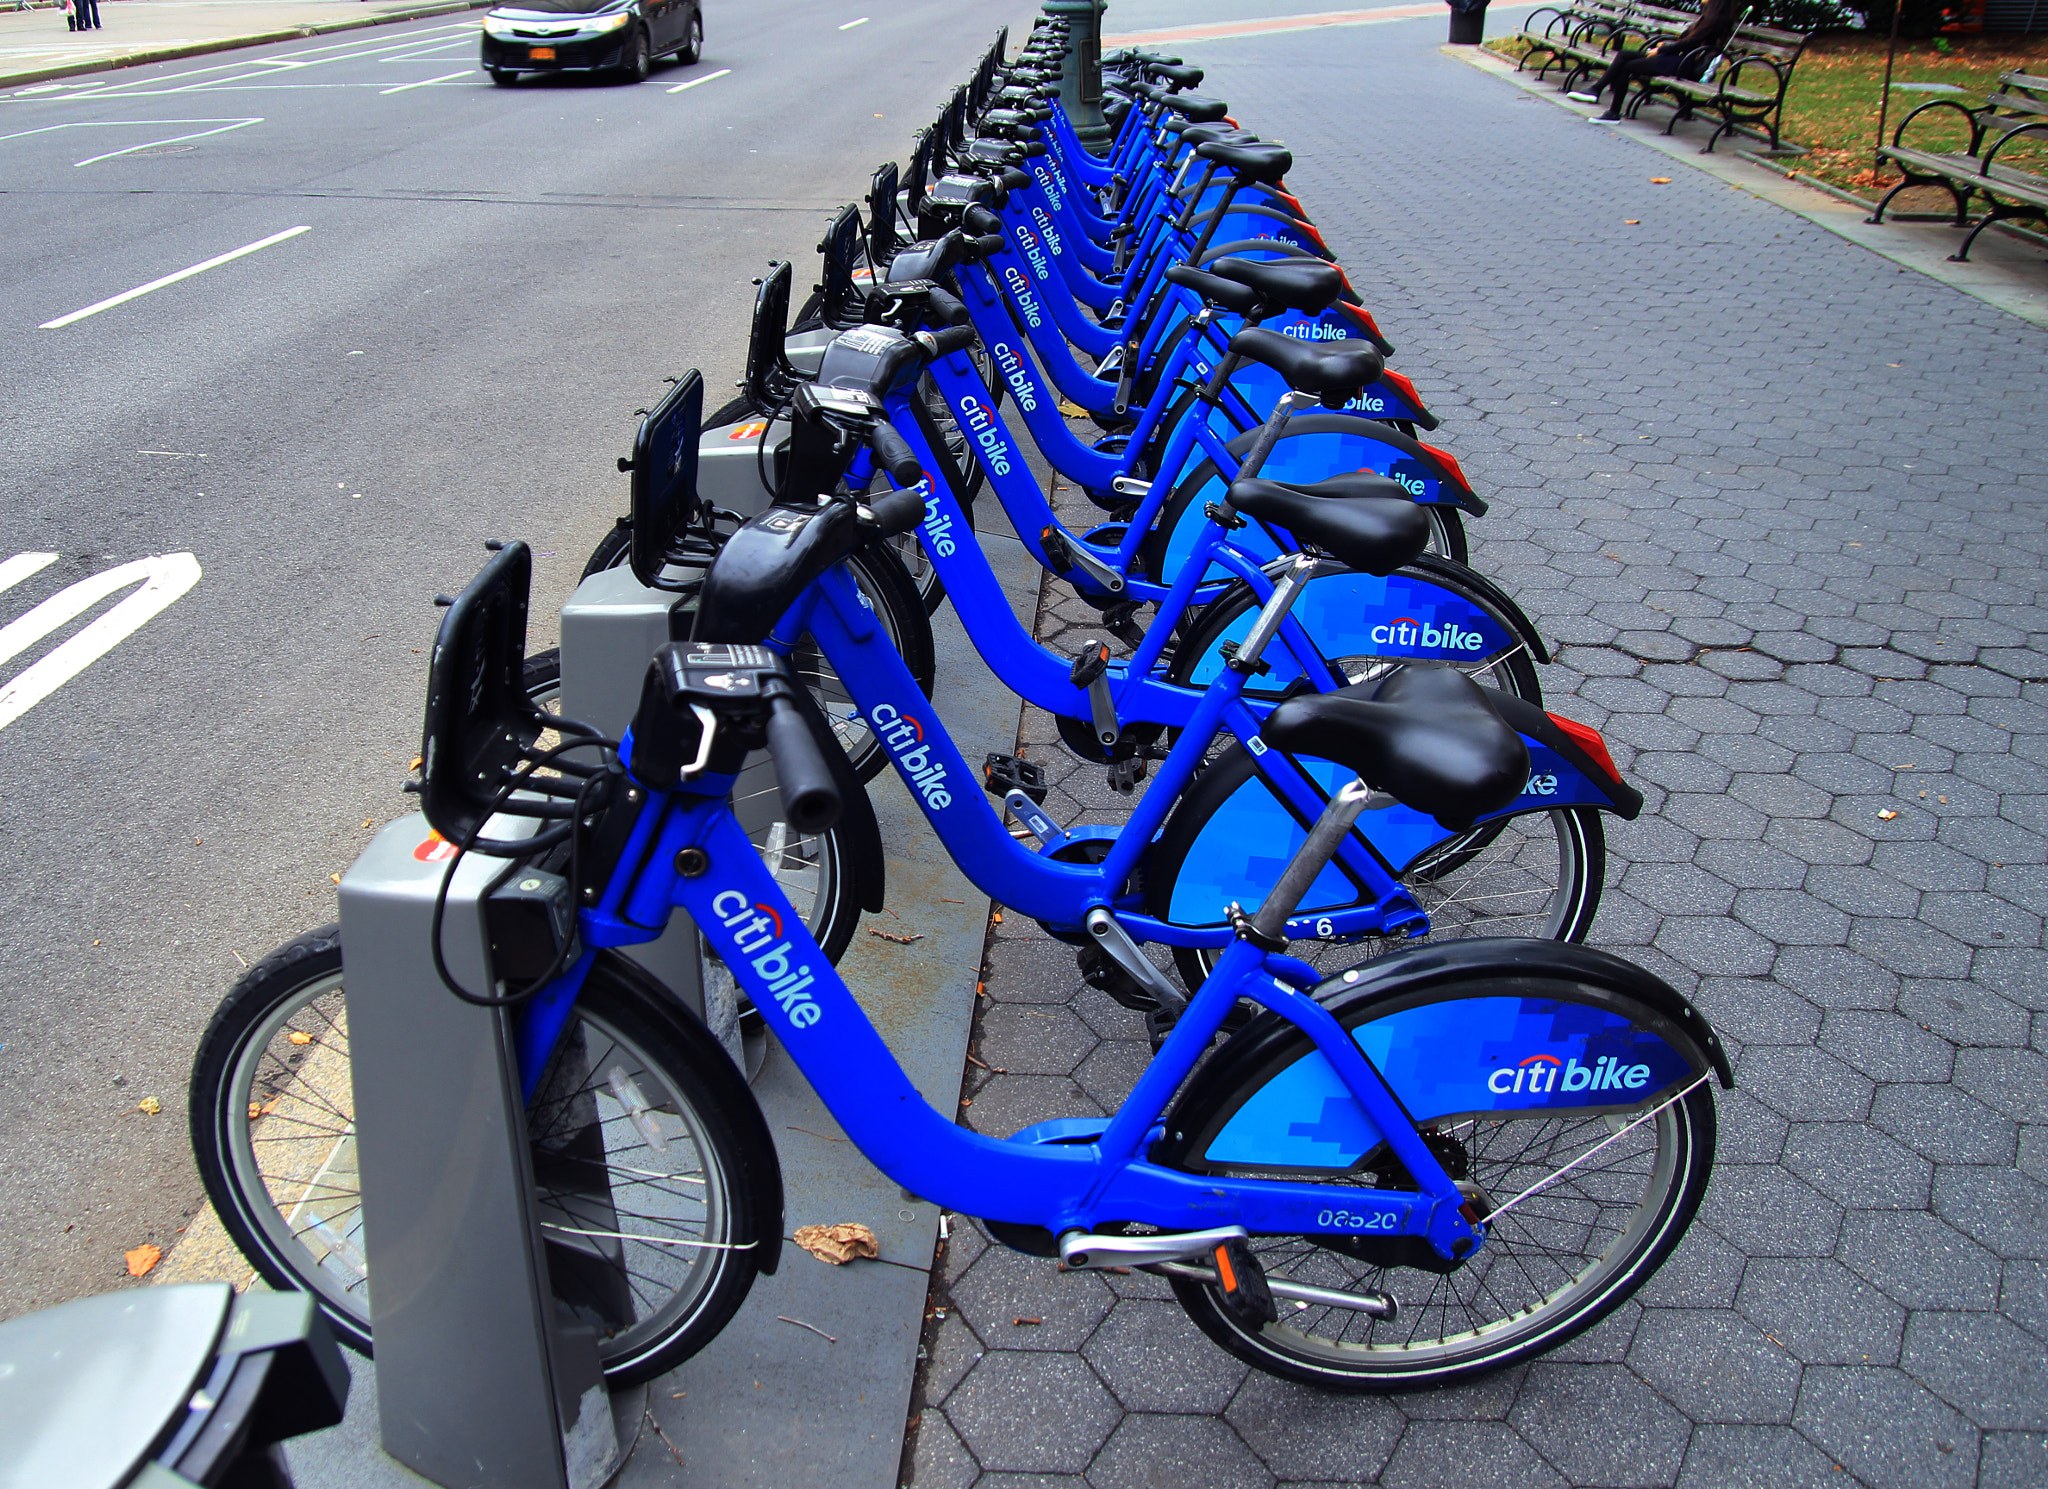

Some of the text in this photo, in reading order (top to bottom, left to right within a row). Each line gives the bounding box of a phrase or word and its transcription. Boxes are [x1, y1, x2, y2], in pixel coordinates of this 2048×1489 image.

[1016, 225, 1049, 280] citi bike
[1042, 225, 1062, 256] bike
[1004, 267, 1042, 329] citi bike
[994, 342, 1037, 413] citi bike
[960, 395, 1011, 477] citi bike
[1370, 617, 1483, 651] citi bike
[871, 703, 952, 811] citi bike
[712, 889, 822, 1030] citi bike
[1487, 1054, 1650, 1094] citi bike
